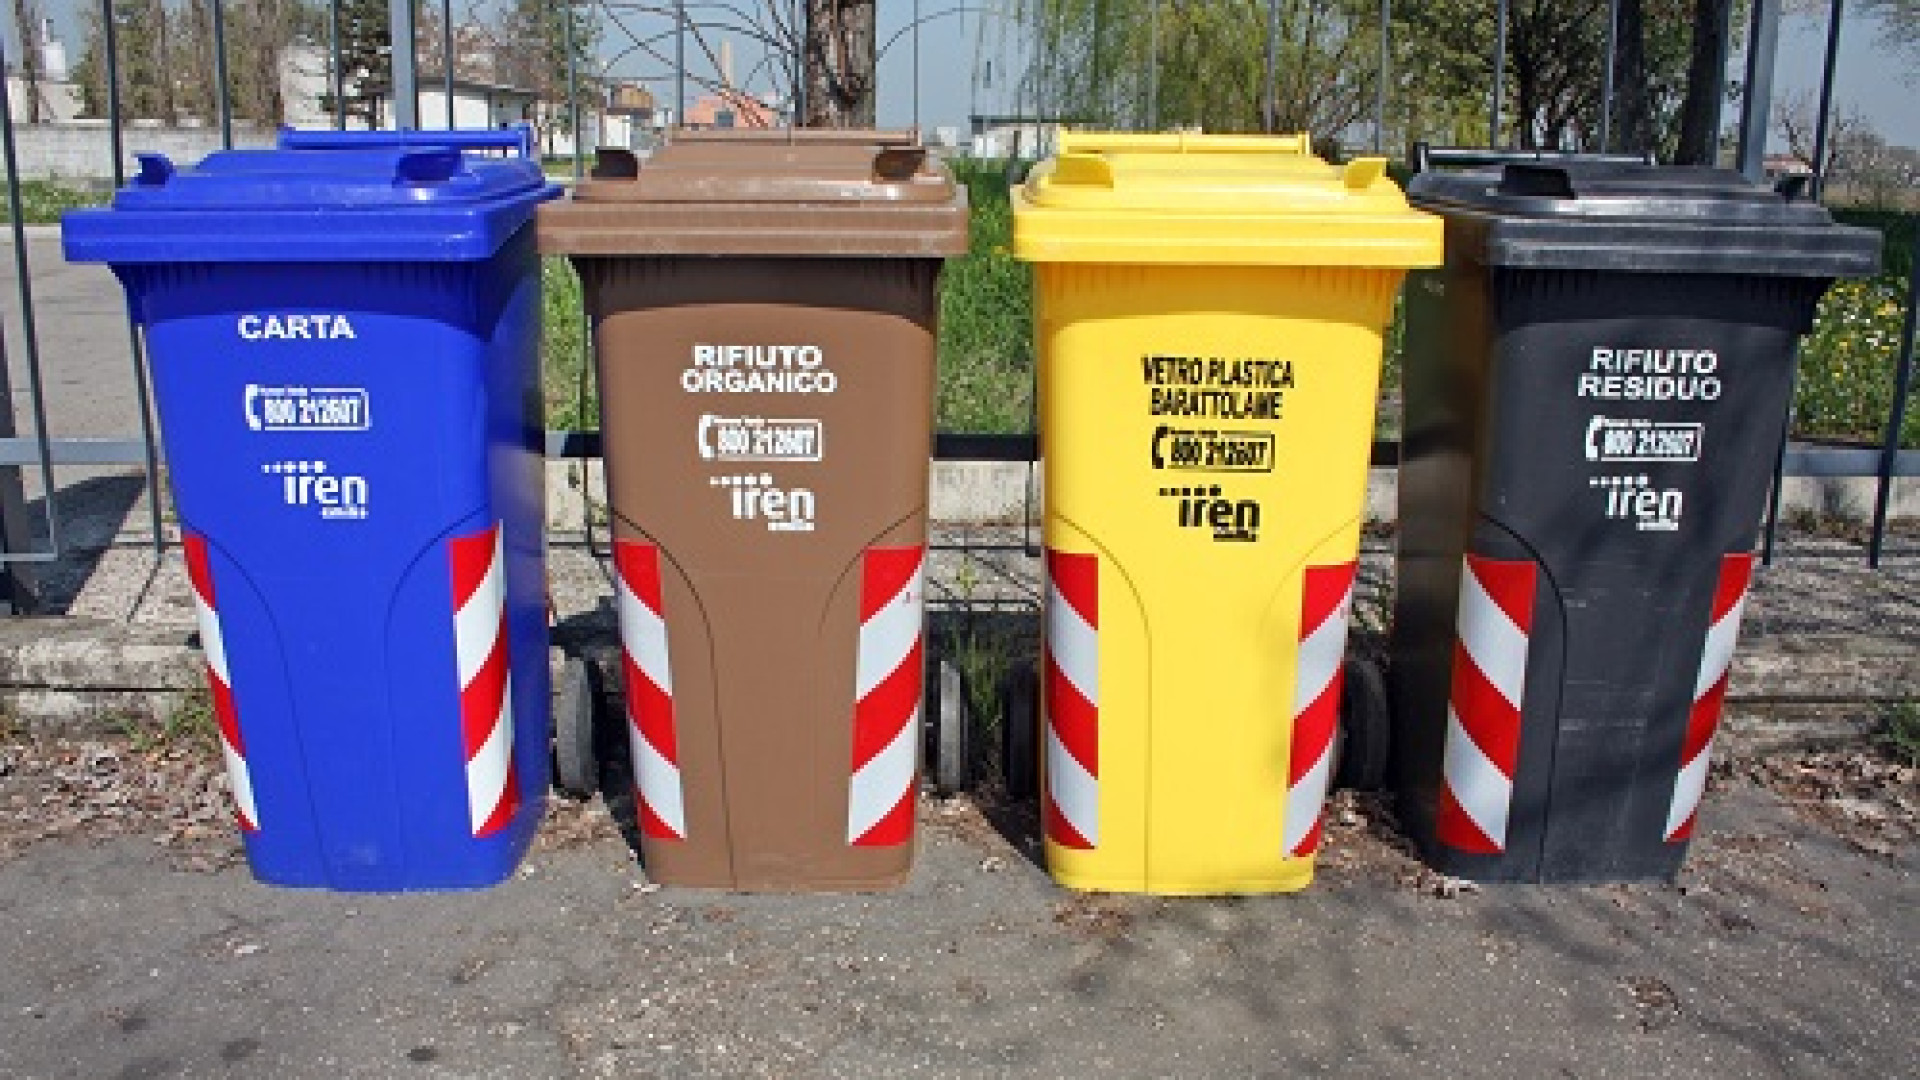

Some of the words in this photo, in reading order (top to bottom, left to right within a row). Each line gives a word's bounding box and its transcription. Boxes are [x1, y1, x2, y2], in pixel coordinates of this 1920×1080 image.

[238, 314, 357, 339] CARTA
[692, 345, 822, 368] RIFIUTO
[1589, 347, 1718, 373] RIFIUTO
[680, 370, 837, 393] ORGANICO
[1141, 357, 1203, 385] VETRO
[1205, 357, 1294, 388] PLASTICA
[1577, 373, 1721, 400] RESIDUO
[264, 398, 297, 424] 800
[1148, 387, 1283, 419] BARATTOLAME
[1171, 438, 1203, 465] 800
[283, 461, 369, 505] iren
[732, 474, 815, 519] iren
[1179, 486, 1260, 527] iren
[1604, 475, 1682, 519] iren
